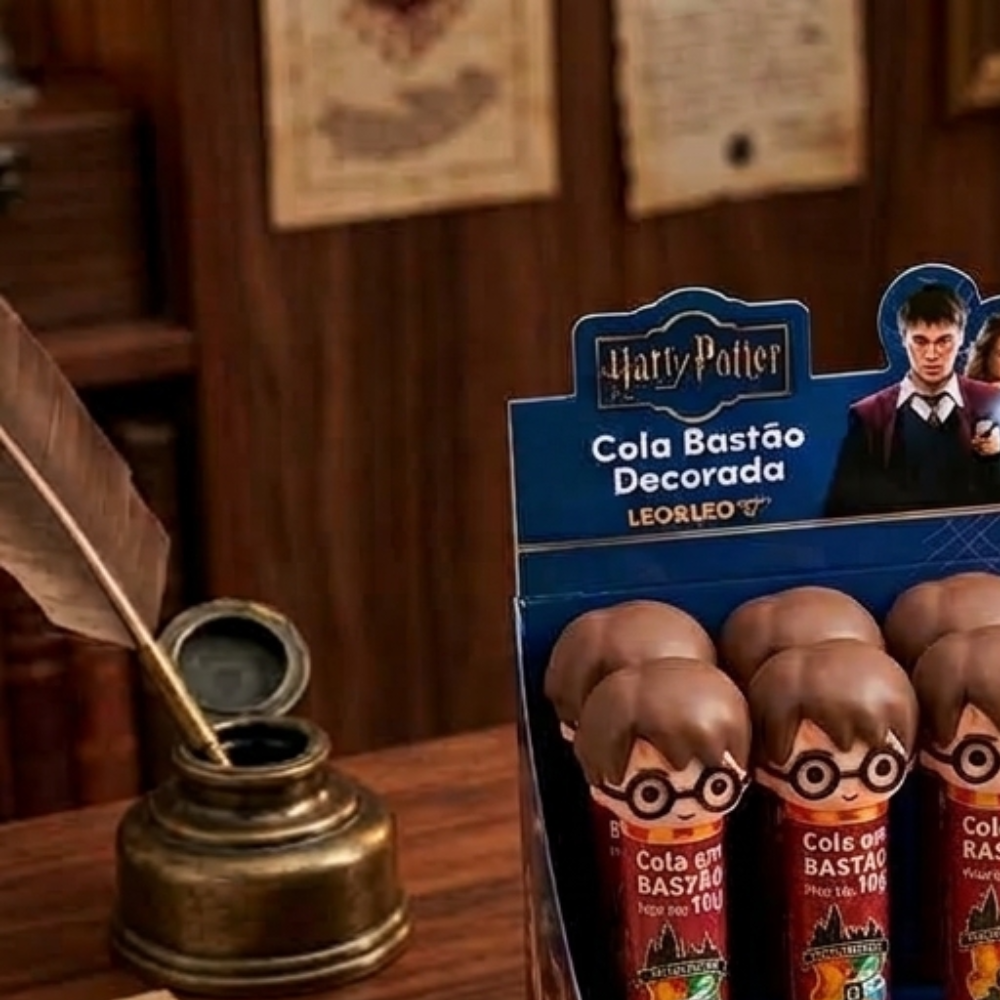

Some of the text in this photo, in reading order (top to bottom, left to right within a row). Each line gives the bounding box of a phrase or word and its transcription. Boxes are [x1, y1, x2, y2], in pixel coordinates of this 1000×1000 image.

[592, 421, 806, 463] Cola Bastão
[613, 455, 785, 496] Decorada
